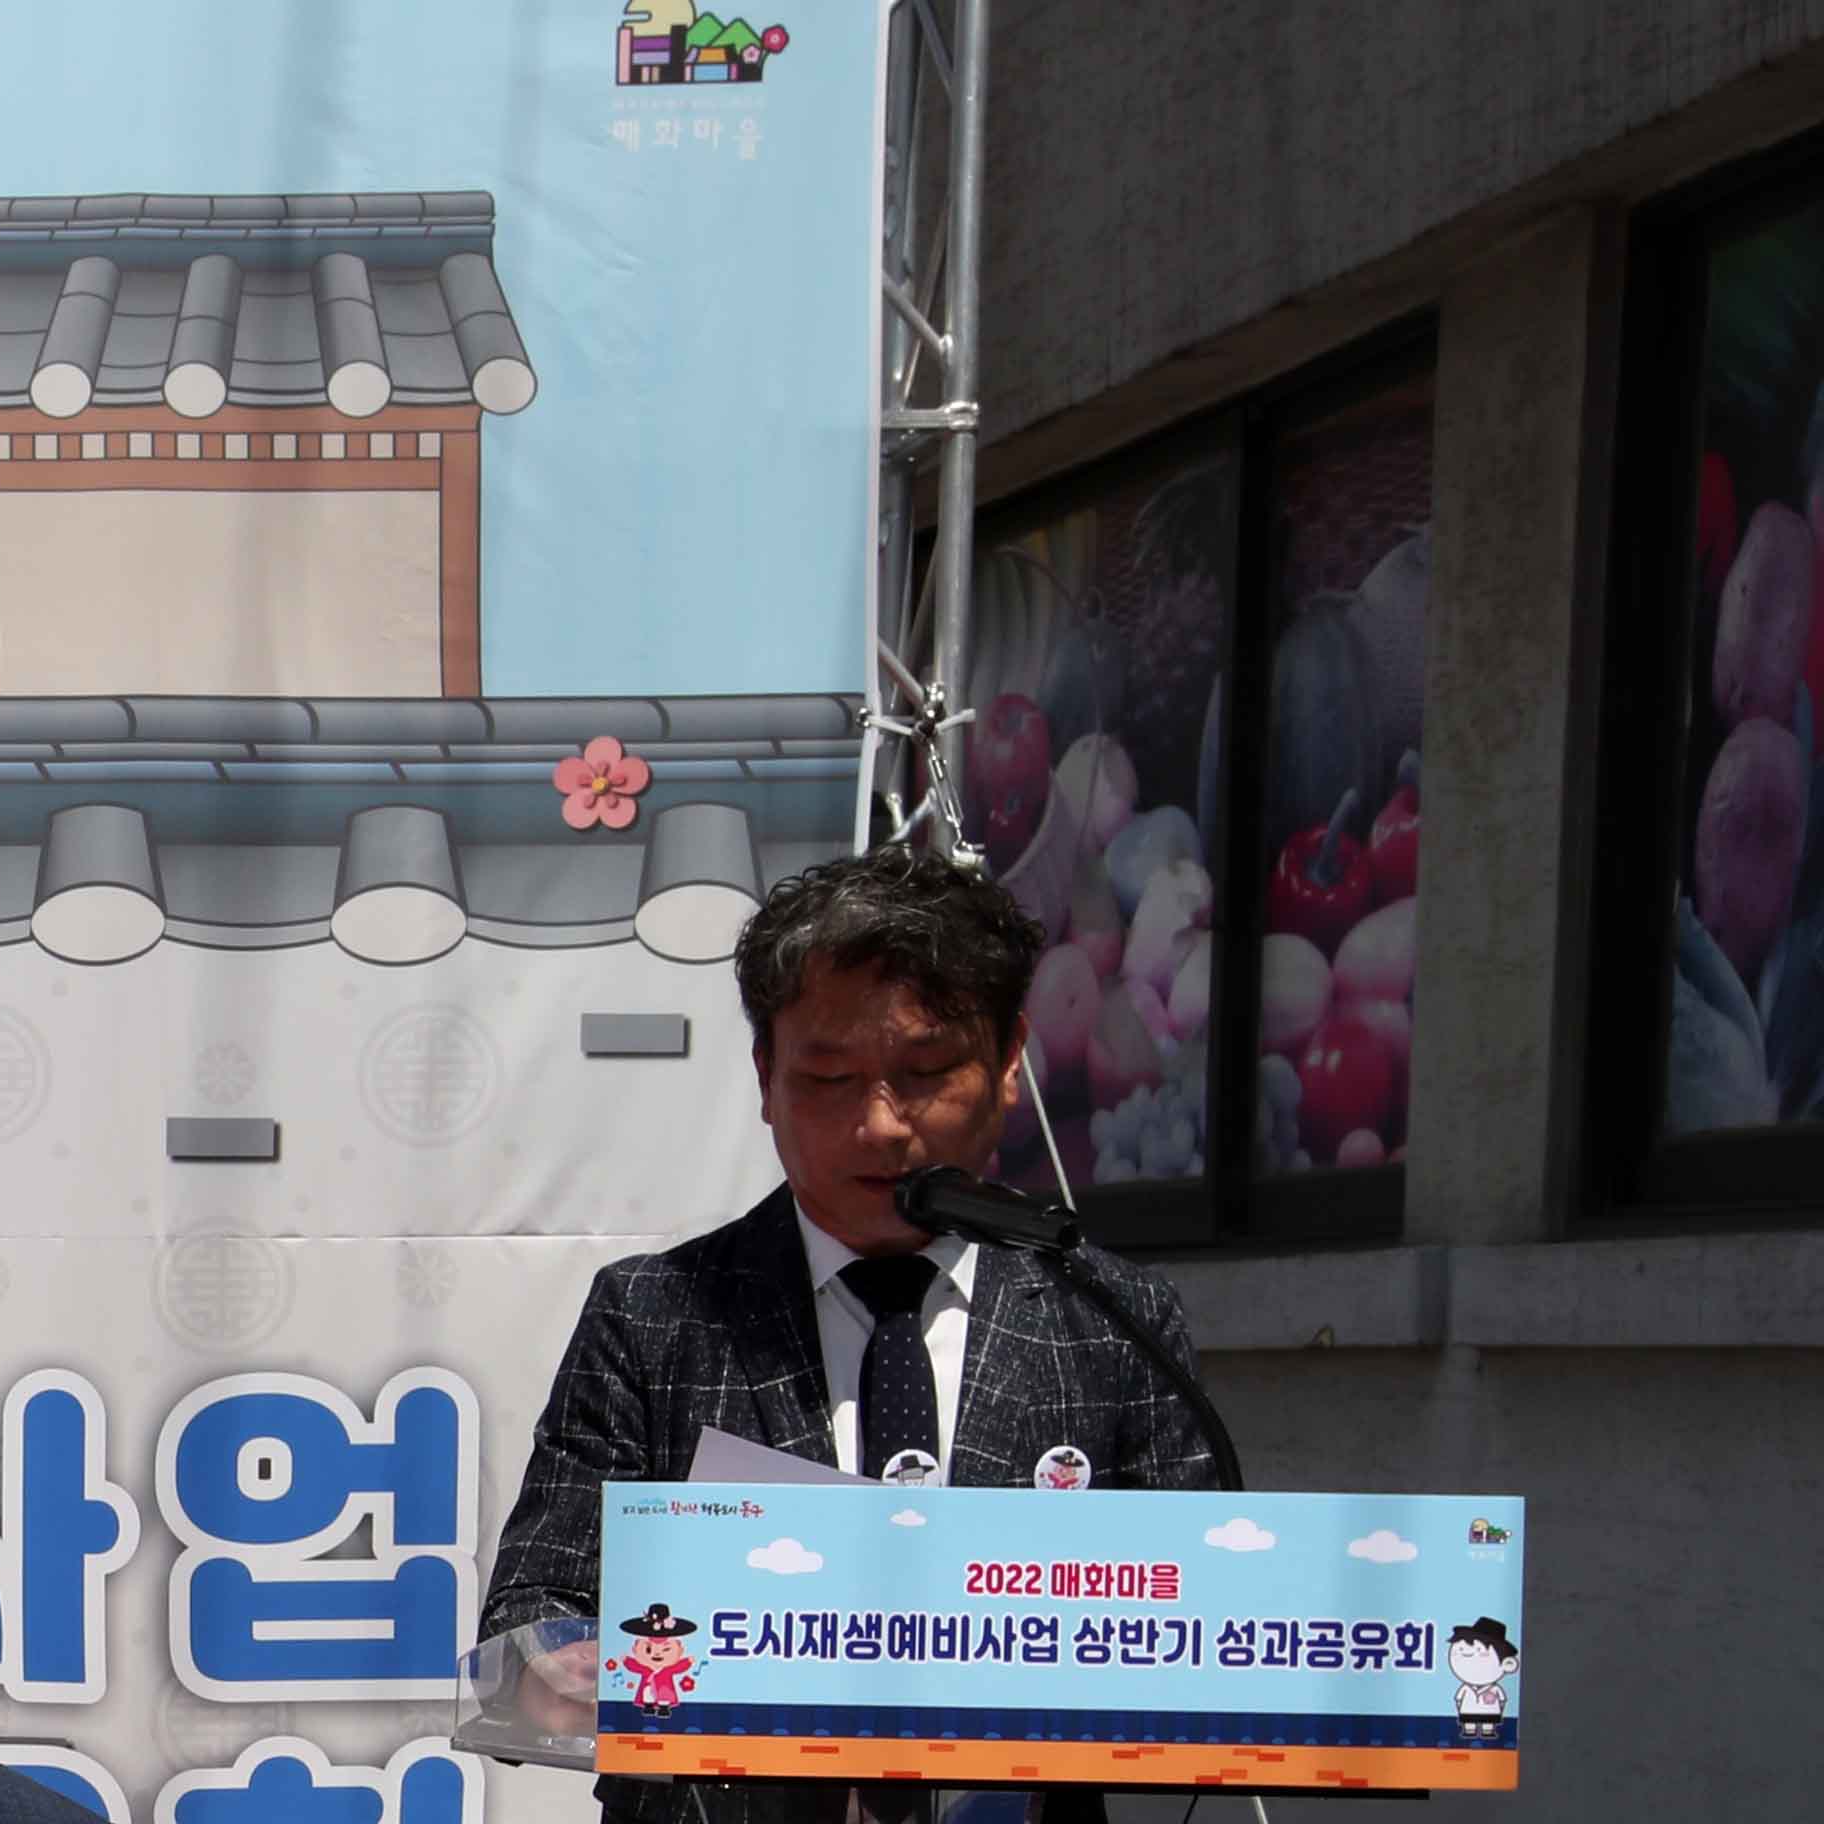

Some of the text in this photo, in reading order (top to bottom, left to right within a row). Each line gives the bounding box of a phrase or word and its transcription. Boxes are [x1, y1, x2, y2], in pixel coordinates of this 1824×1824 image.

[964, 1561, 1182, 1602] 2022 매화마을
[707, 1609, 1437, 1672] 도시재생예비사업 상반기 성과공유회
